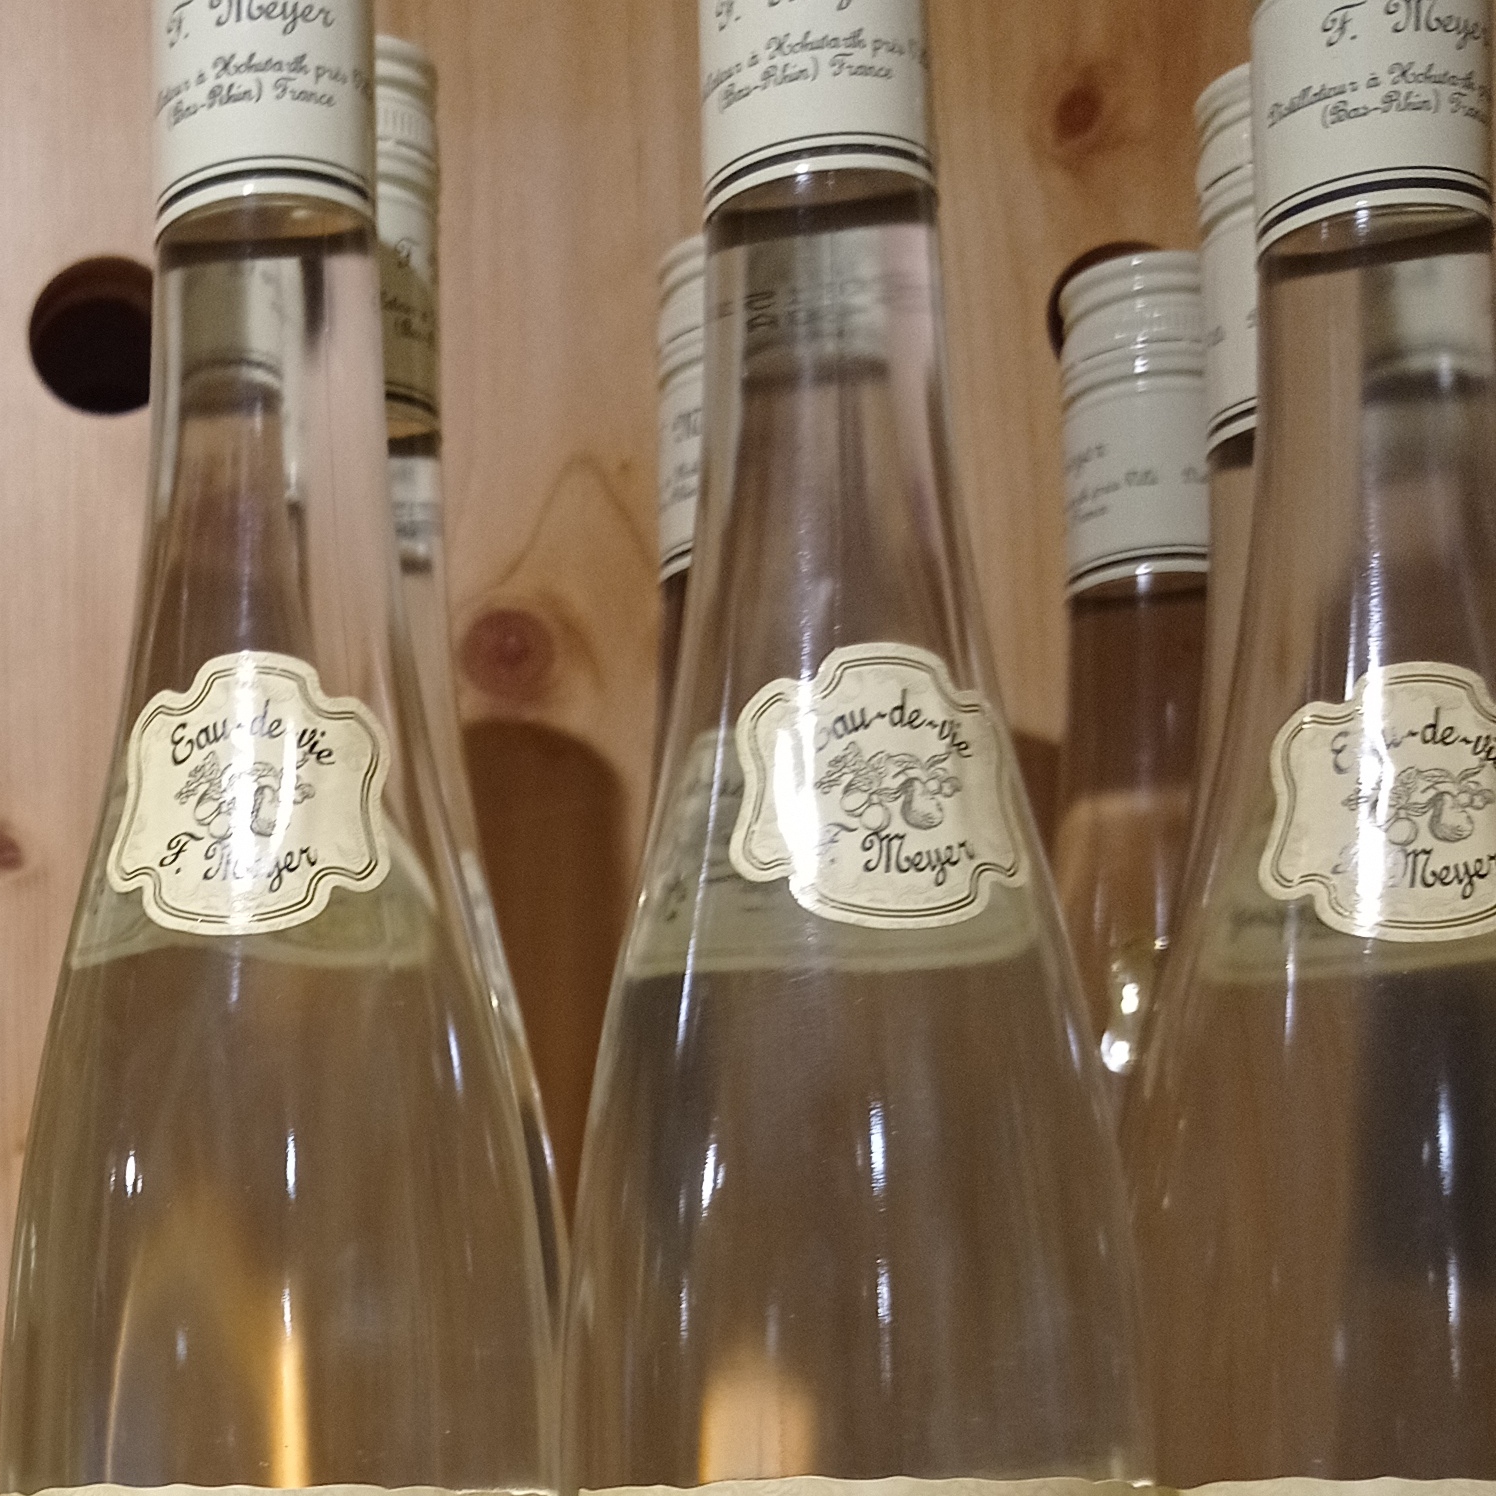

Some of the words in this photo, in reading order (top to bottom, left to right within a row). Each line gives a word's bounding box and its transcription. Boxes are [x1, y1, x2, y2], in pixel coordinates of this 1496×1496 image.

[1321, 0, 1368, 47] F.
[170, 698, 337, 766] Eau-devie
[158, 831, 205, 876] F.
[860, 830, 976, 887] Meyer
